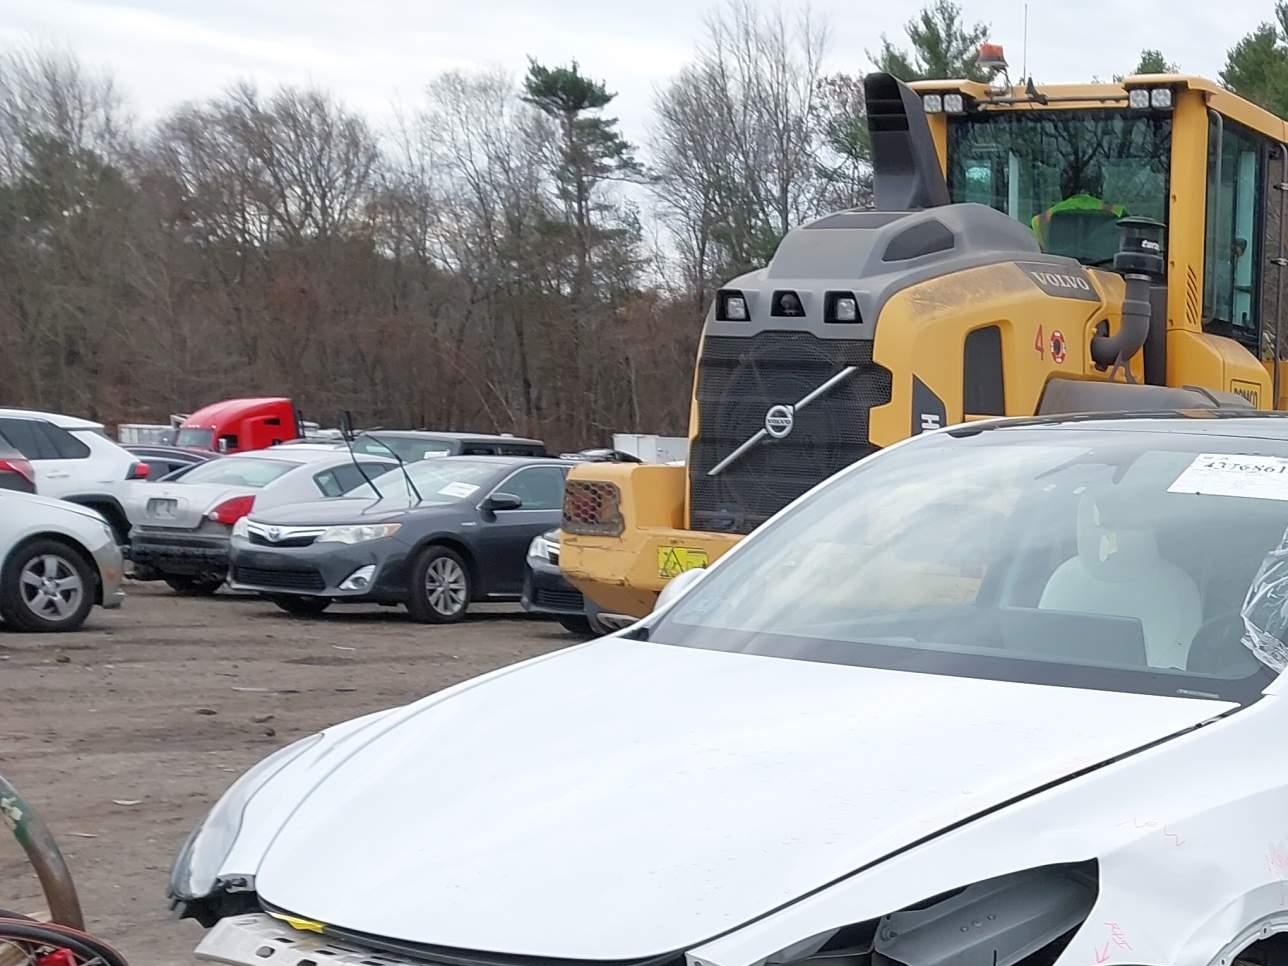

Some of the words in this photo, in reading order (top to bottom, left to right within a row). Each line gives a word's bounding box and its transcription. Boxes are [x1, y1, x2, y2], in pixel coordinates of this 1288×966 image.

[1030, 271, 1090, 291] VOLVO
[1034, 324, 1045, 361] 4
[767, 418, 792, 426] VOLVO
